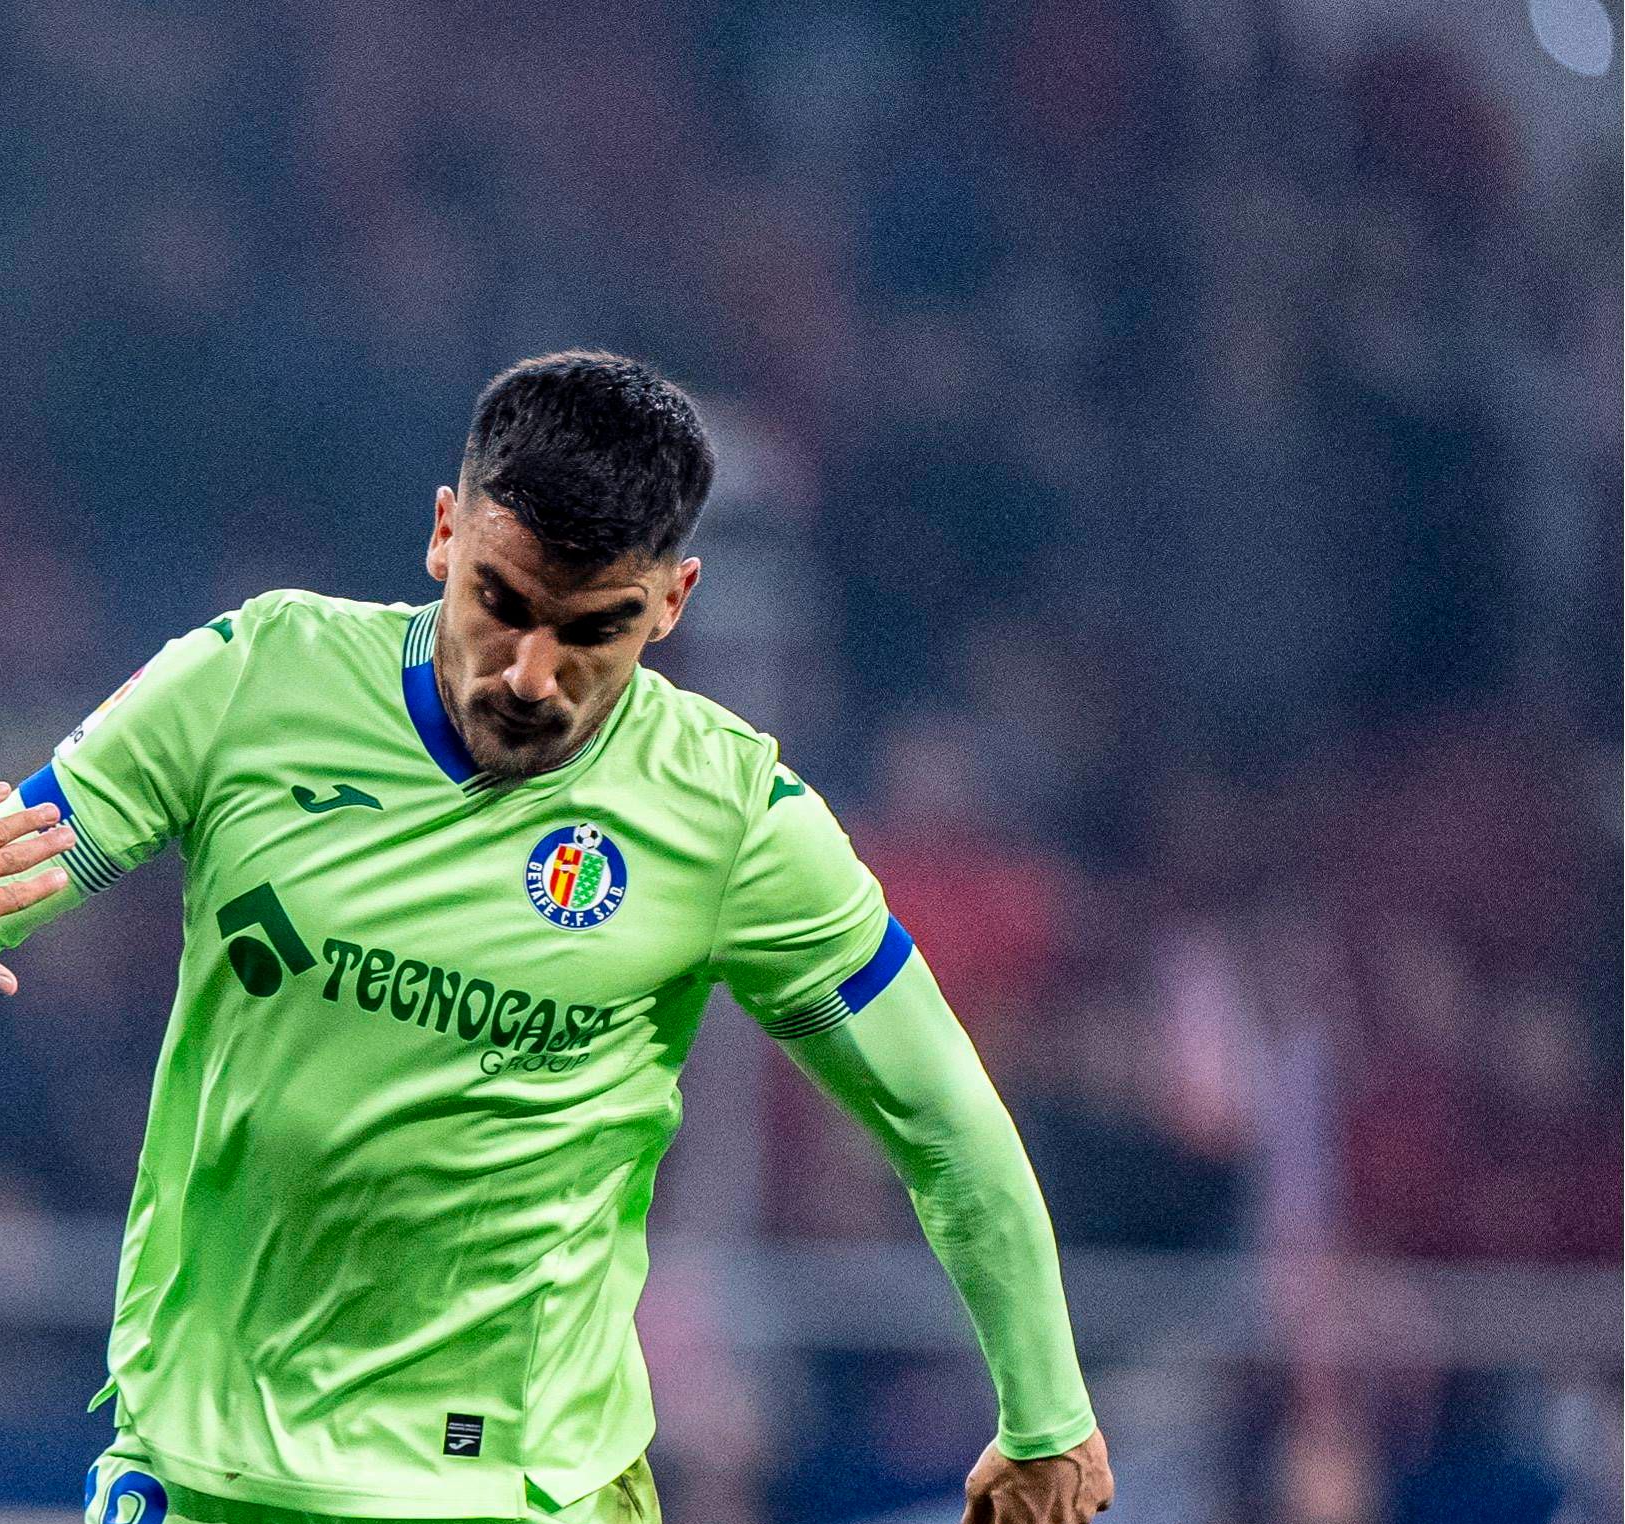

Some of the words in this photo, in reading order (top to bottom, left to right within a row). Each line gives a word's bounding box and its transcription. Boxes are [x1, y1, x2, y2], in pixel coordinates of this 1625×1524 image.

[527, 860, 558, 917] GETAFE
[560, 911, 589, 927] C.F.
[480, 1050, 591, 1076] GROUP
